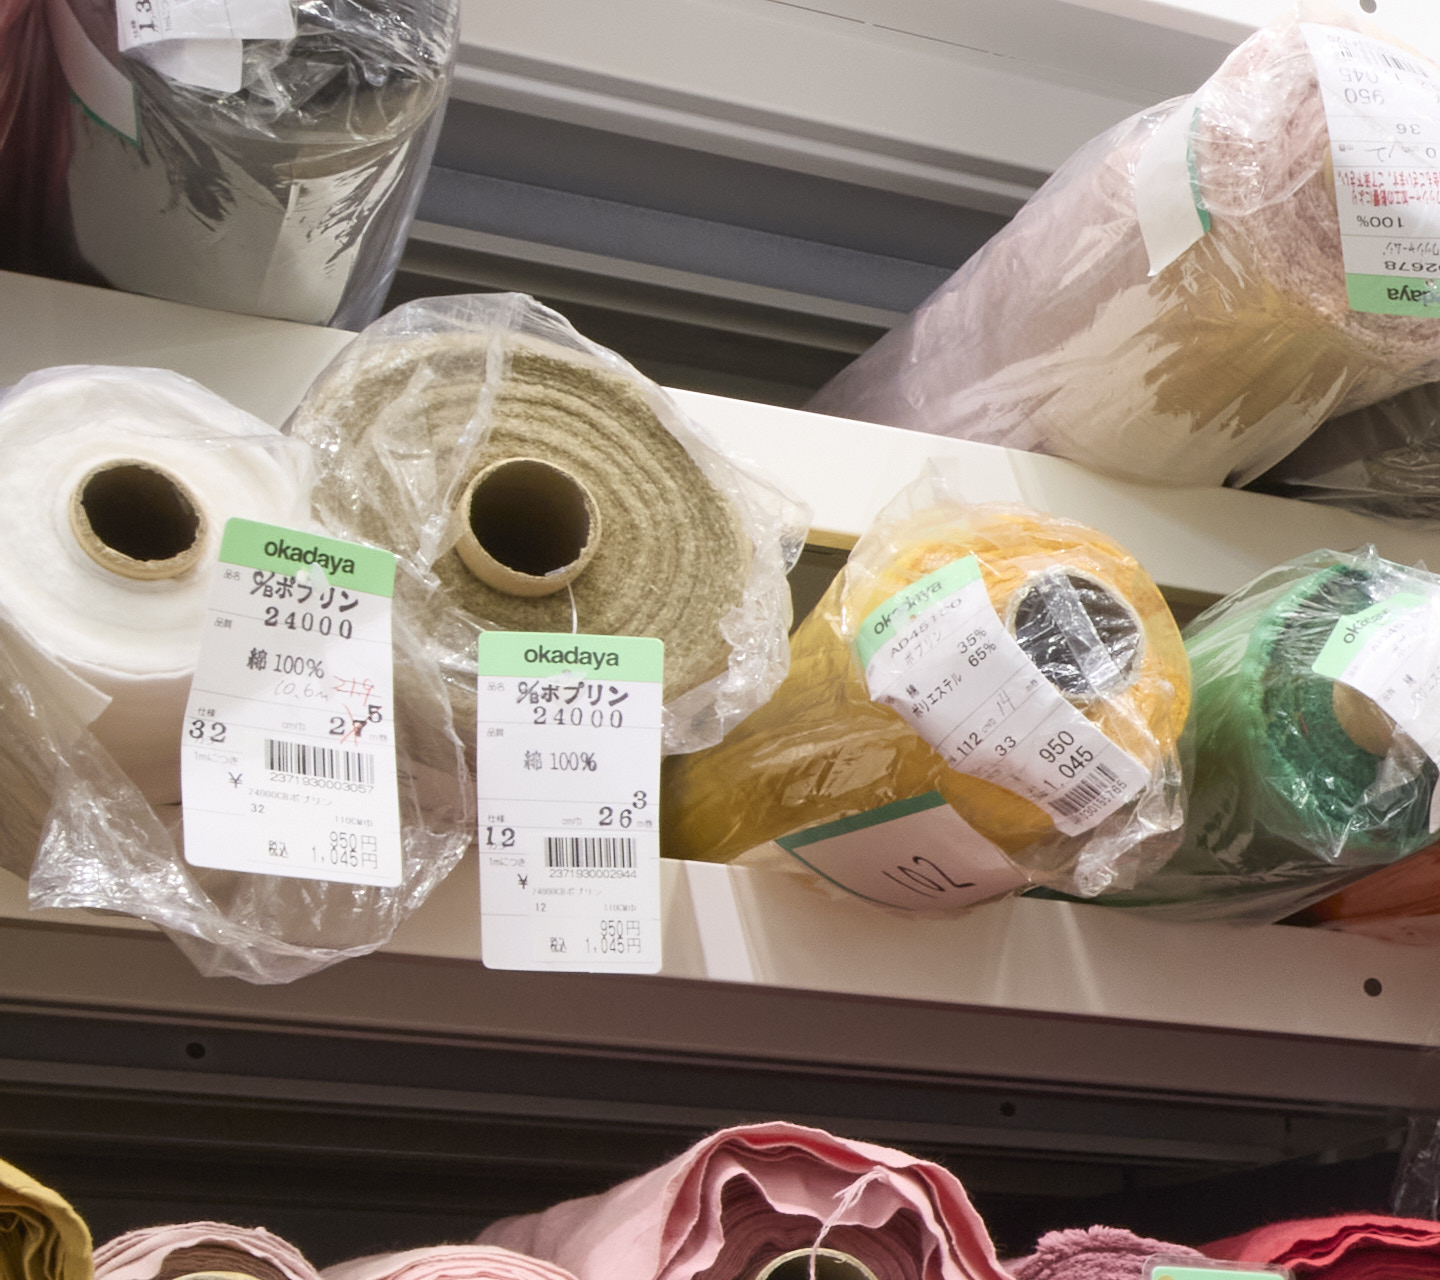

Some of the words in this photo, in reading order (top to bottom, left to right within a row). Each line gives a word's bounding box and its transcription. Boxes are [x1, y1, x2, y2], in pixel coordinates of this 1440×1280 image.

[264, 539, 355, 575] okadaya
[264, 606, 352, 639] 24000
[273, 654, 324, 679] 100%
[524, 645, 619, 670] okadaya
[533, 706, 623, 728] 24000
[189, 719, 226, 743] 32
[551, 752, 597, 772] 100%
[487, 826, 515, 848] 12
